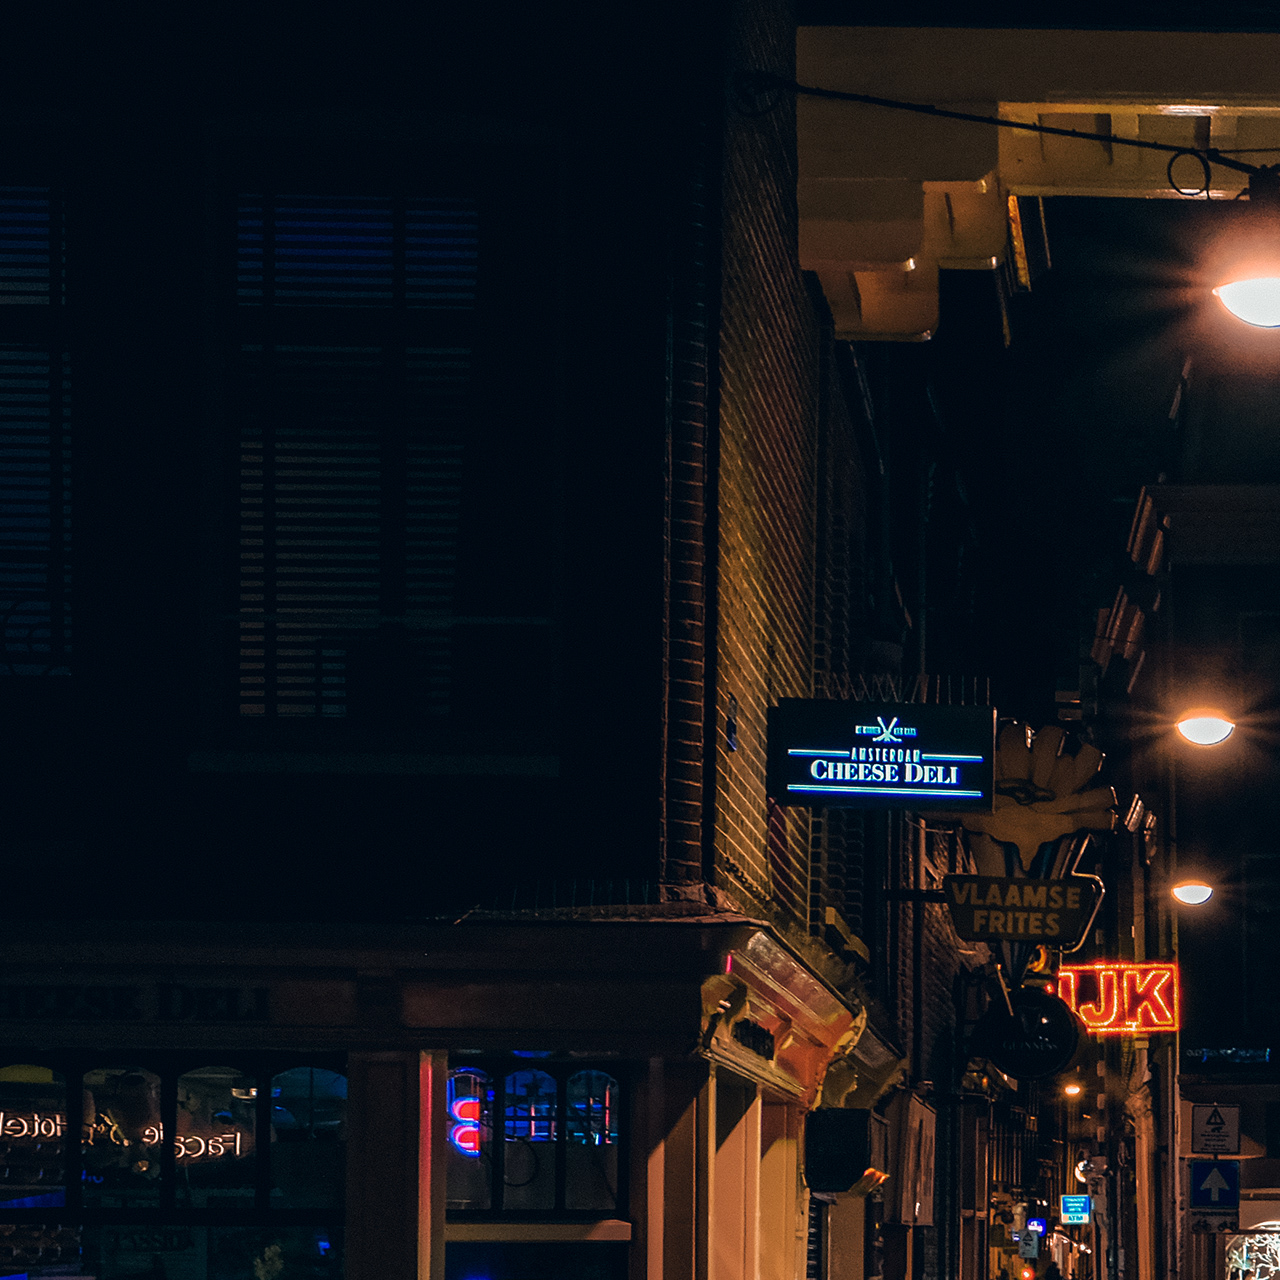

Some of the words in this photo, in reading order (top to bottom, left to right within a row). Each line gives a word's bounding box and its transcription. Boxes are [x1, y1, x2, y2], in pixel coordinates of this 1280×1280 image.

[851, 747, 920, 763] AMSTERDAM
[811, 759, 898, 781] CHEESE
[904, 763, 958, 784] DELI
[952, 882, 1081, 909] VLAAMSE
[973, 909, 1060, 936] FRITES
